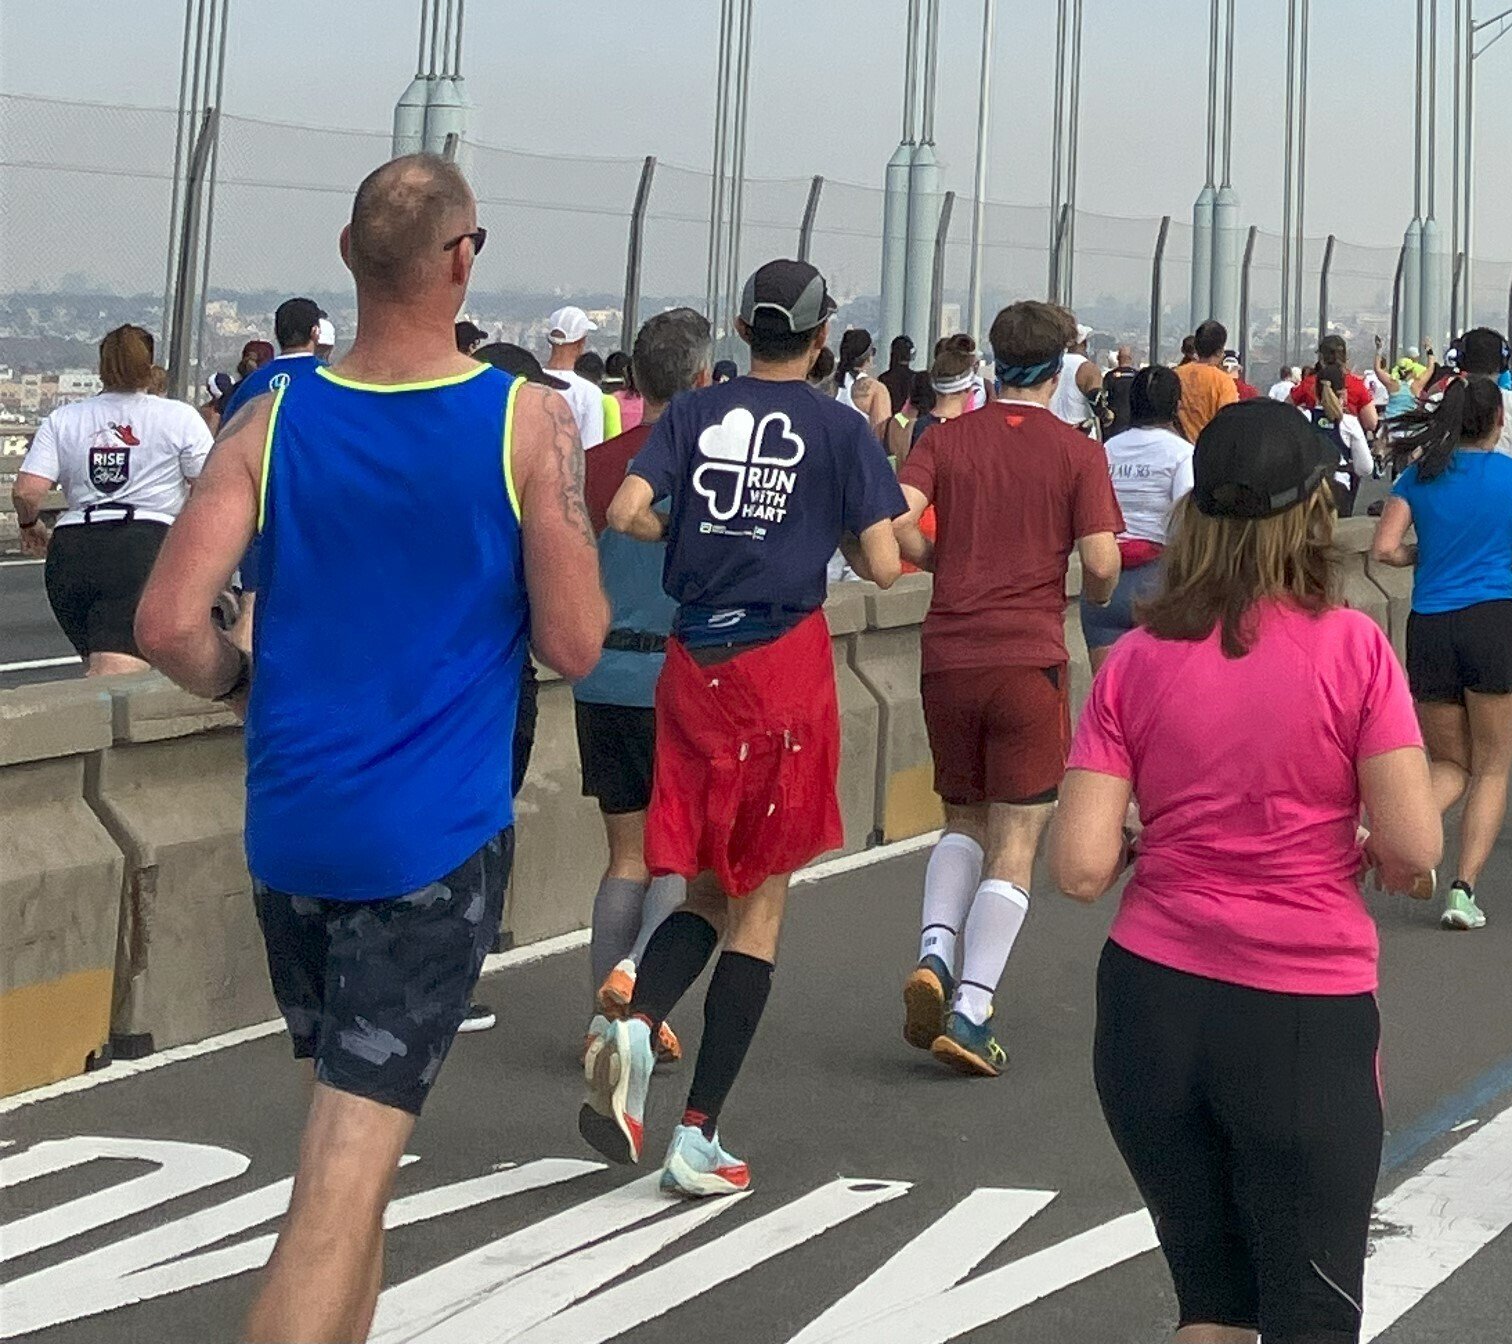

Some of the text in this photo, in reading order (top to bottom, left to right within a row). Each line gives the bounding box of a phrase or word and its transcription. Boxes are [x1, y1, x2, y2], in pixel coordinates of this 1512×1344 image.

[93, 452, 126, 466] RISE
[747, 466, 797, 494] RUN
[750, 489, 787, 507] WITH
